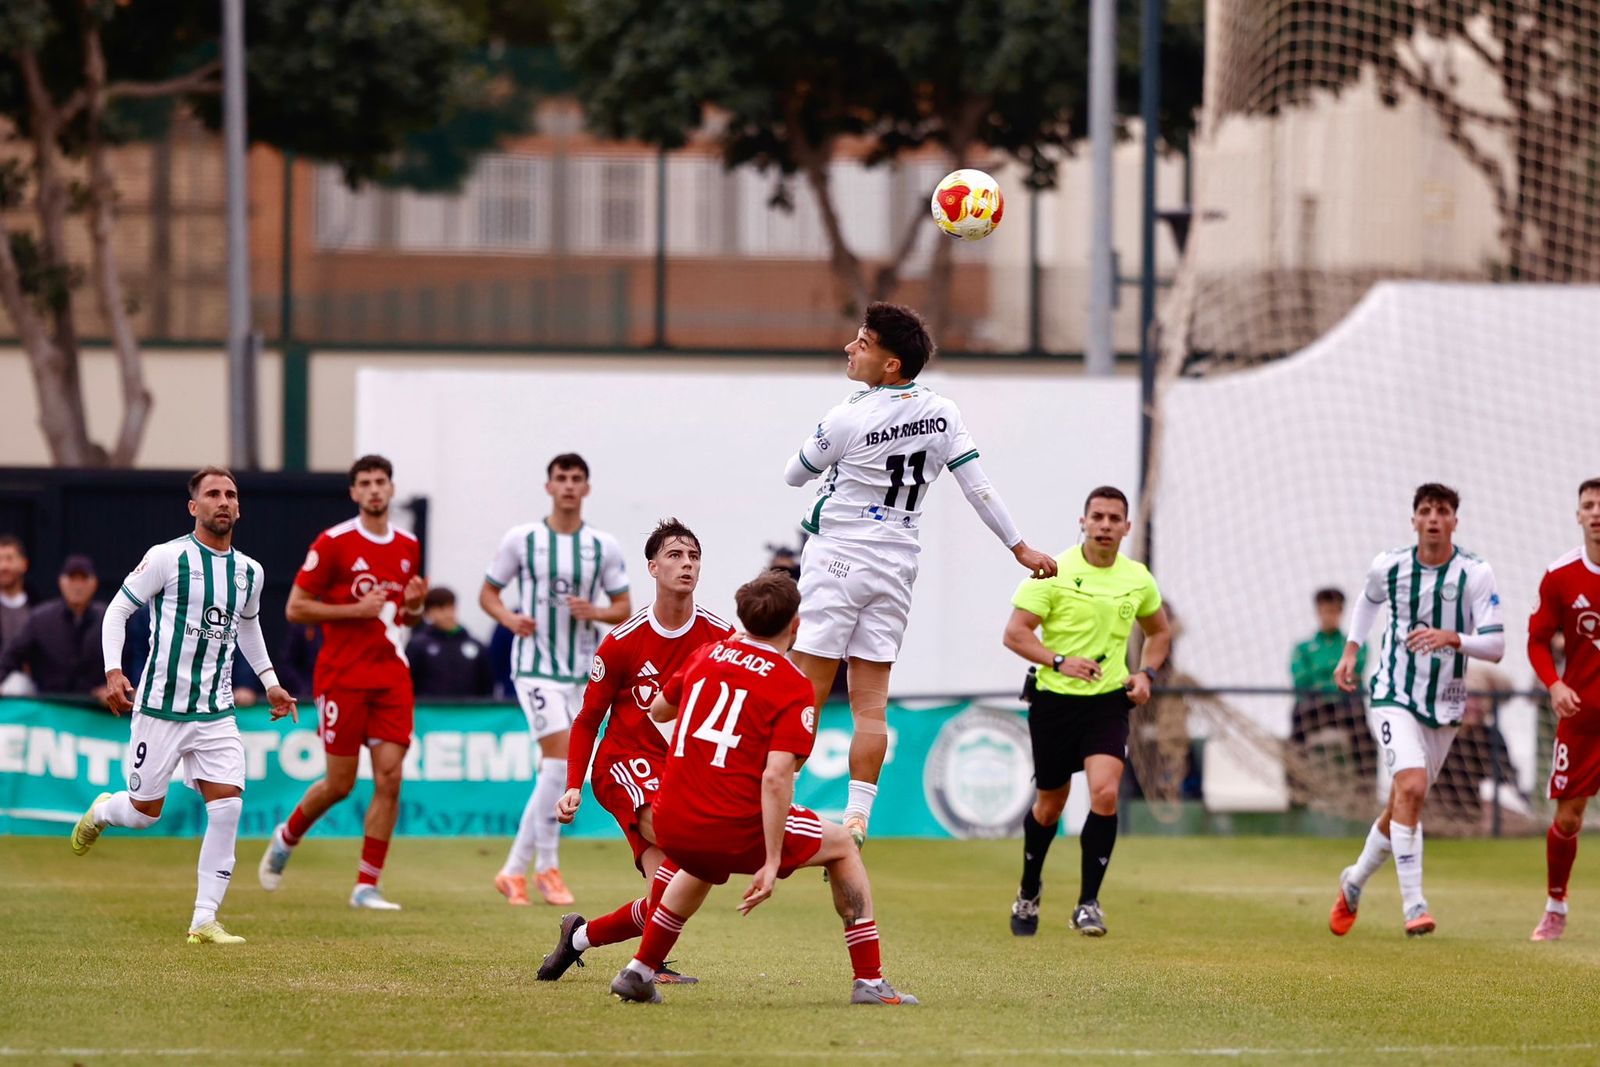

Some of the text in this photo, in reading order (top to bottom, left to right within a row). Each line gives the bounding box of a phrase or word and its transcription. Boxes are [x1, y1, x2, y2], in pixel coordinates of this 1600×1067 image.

[865, 417, 948, 446] IBAN RIBEIRO
[883, 450, 927, 512] 11
[827, 563, 848, 579] laga
[673, 677, 749, 769] 14
[1381, 720, 1392, 745] 8
[133, 741, 148, 770] 9
[1556, 742, 1570, 773] 8
